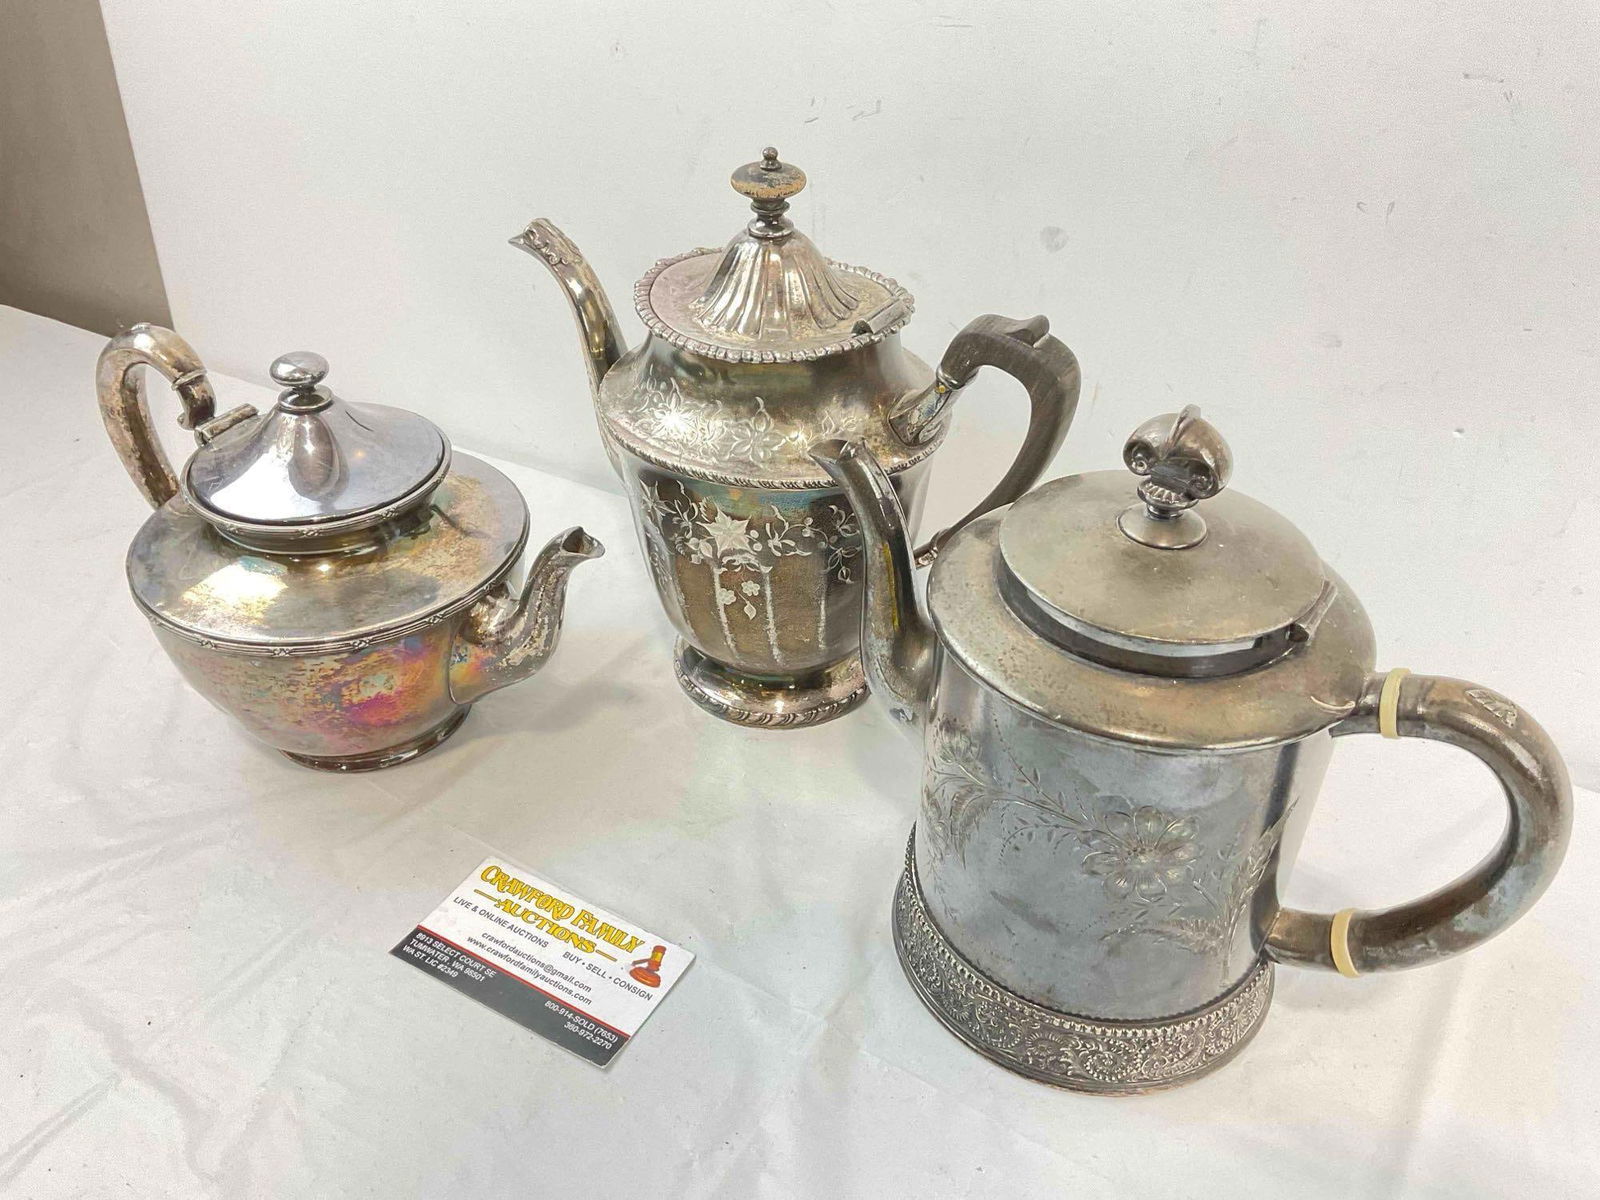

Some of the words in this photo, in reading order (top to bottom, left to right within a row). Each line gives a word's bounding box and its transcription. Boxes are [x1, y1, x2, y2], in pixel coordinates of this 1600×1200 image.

[453, 896, 472, 910] LIVE
[471, 905, 479, 913] &
[478, 909, 509, 928] ONLINE
[507, 924, 549, 948] AUCTIONS
[481, 865, 575, 921] CRAWFORD
[570, 909, 645, 953] FAMILY
[494, 898, 597, 954] AUCTIONS
[402, 944, 416, 956] WA
[425, 957, 438, 967] LIC
[436, 963, 459, 979] #2349
[415, 932, 434, 945] 8913
[432, 940, 461, 958] SELECT
[459, 954, 486, 972] COURT
[484, 969, 497, 978] SE
[451, 960, 465, 971] WA
[467, 936, 593, 1006] www.crawfordfamilyauctions.com
[481, 932, 592, 993] crawfordauctions@gmail.com
[562, 951, 582, 964] BUY
[585, 963, 607, 979] SELL
[613, 977, 652, 1001] CONSIGN
[544, 1000, 595, 1031] 800-914-SOLD
[593, 1026, 618, 1044] (7653)
[563, 1021, 612, 1050] 360-972-2270
